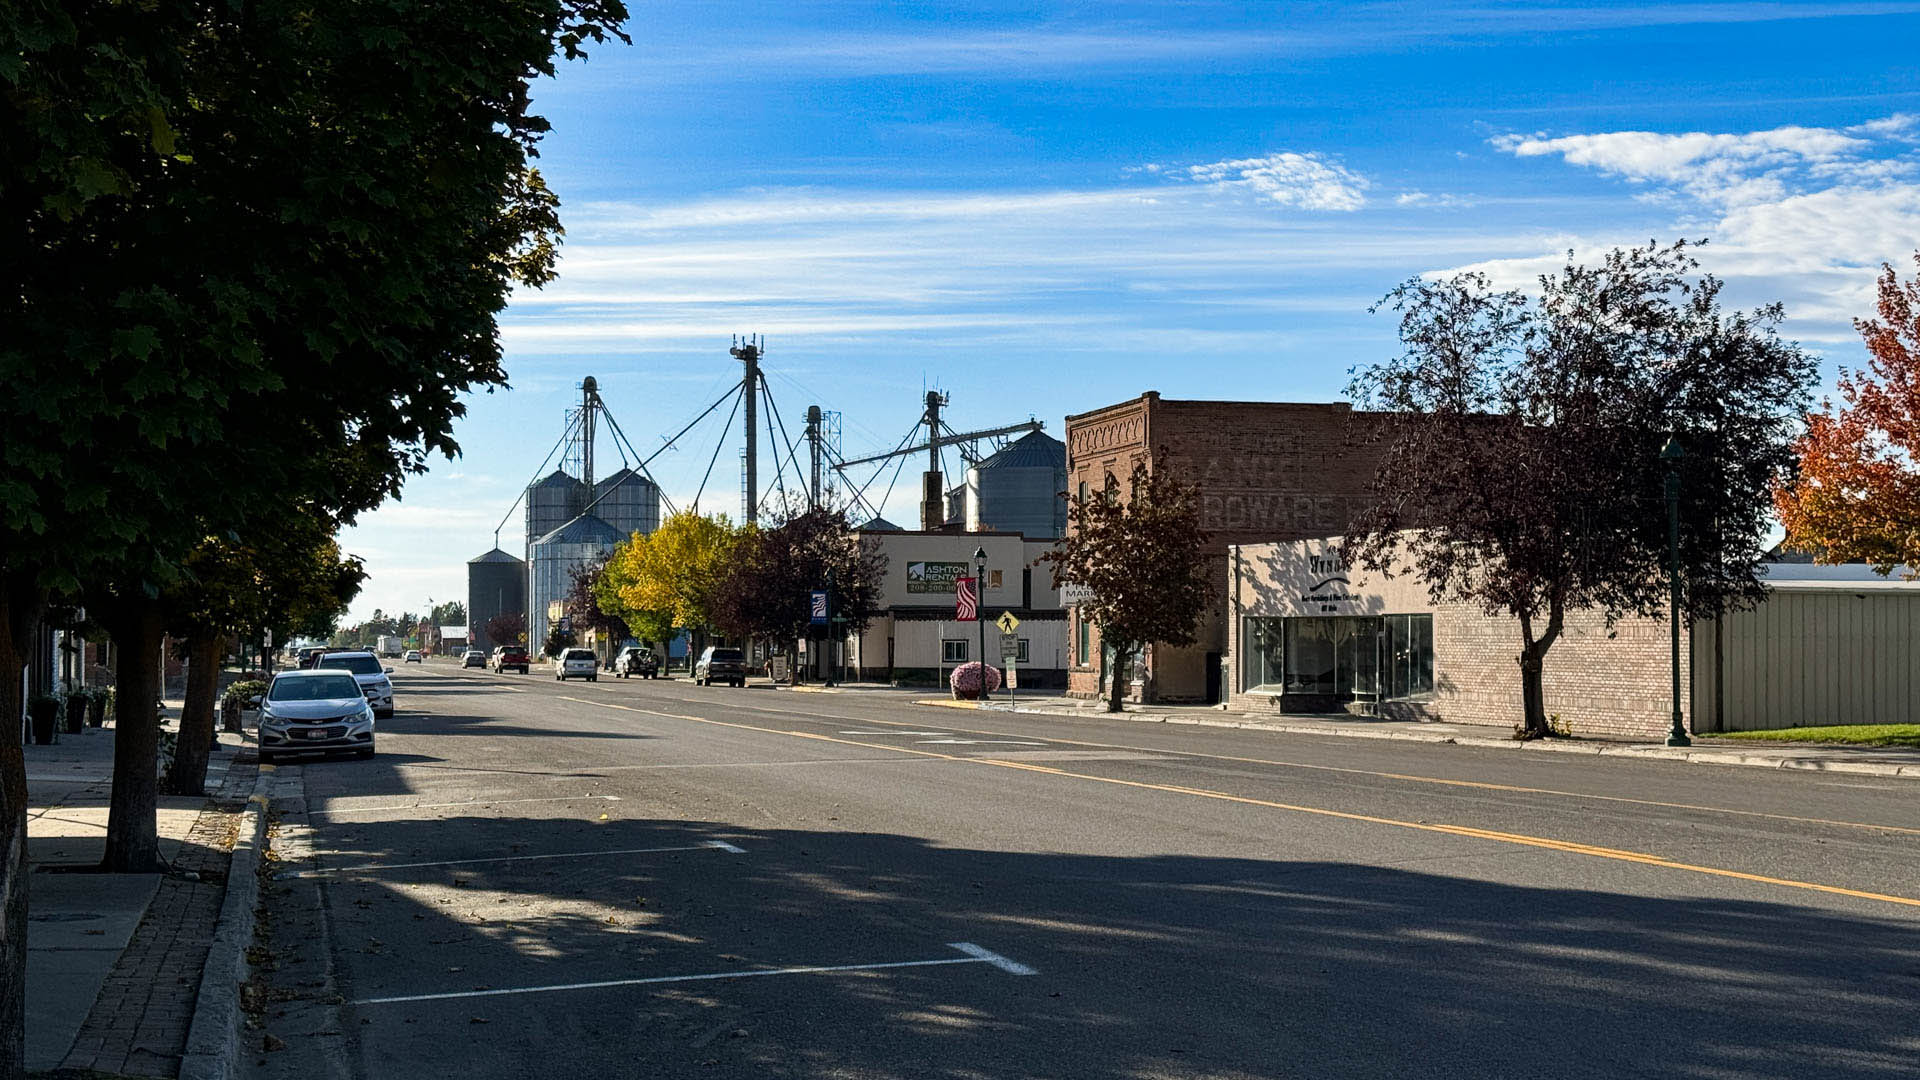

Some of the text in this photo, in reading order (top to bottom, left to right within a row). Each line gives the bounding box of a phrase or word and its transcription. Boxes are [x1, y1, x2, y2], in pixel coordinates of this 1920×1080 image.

[1203, 495, 1335, 529] RDWARE
[925, 565, 967, 574] ASHTON
[1065, 590, 1097, 599] MARK
